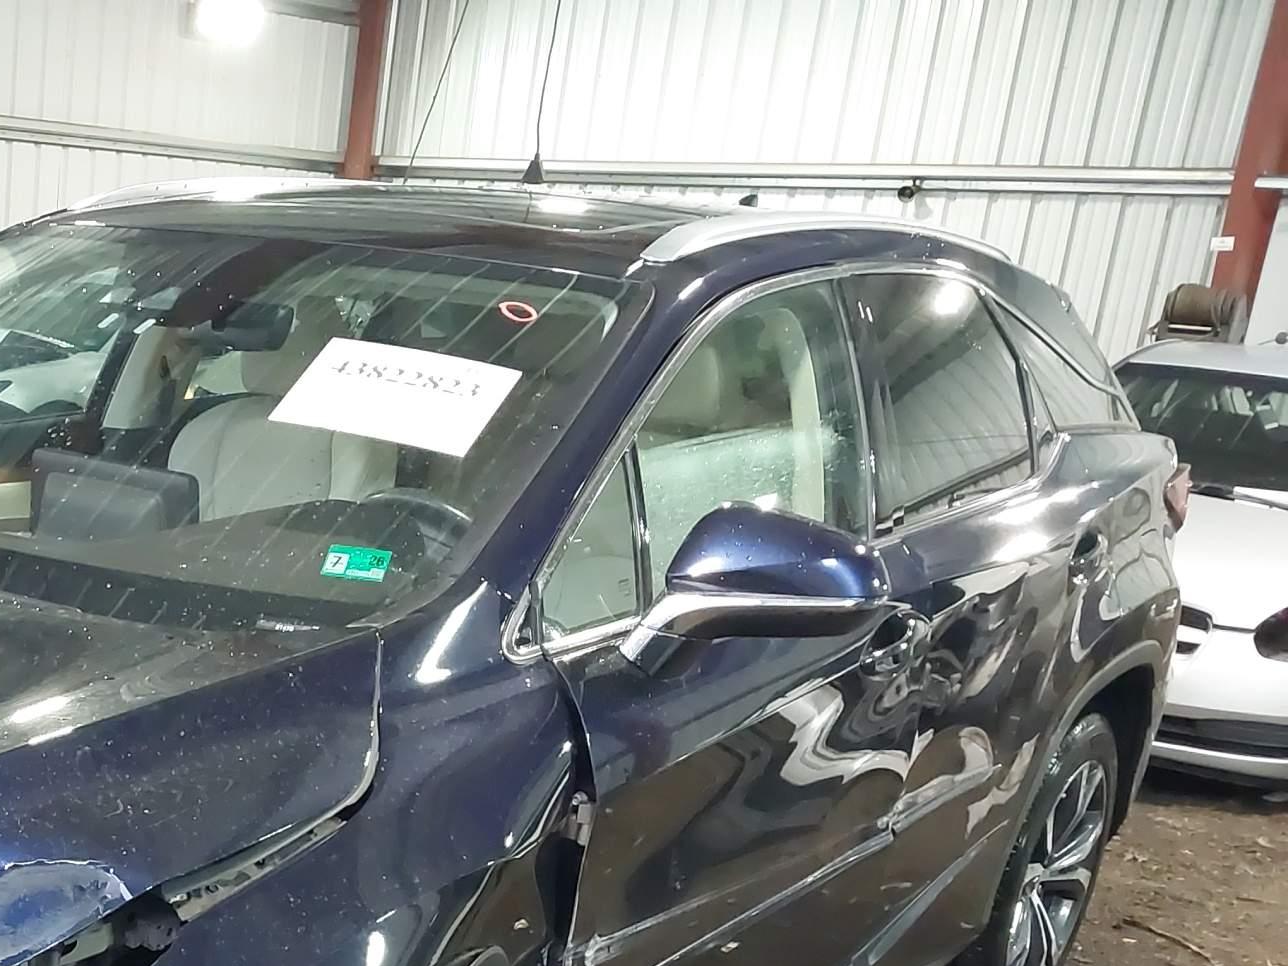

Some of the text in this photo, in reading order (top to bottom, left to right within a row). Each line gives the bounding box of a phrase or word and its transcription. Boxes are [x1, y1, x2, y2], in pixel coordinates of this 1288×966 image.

[330, 360, 481, 398] 43822823
[332, 555, 342, 567] 7
[369, 555, 385, 567] 26
